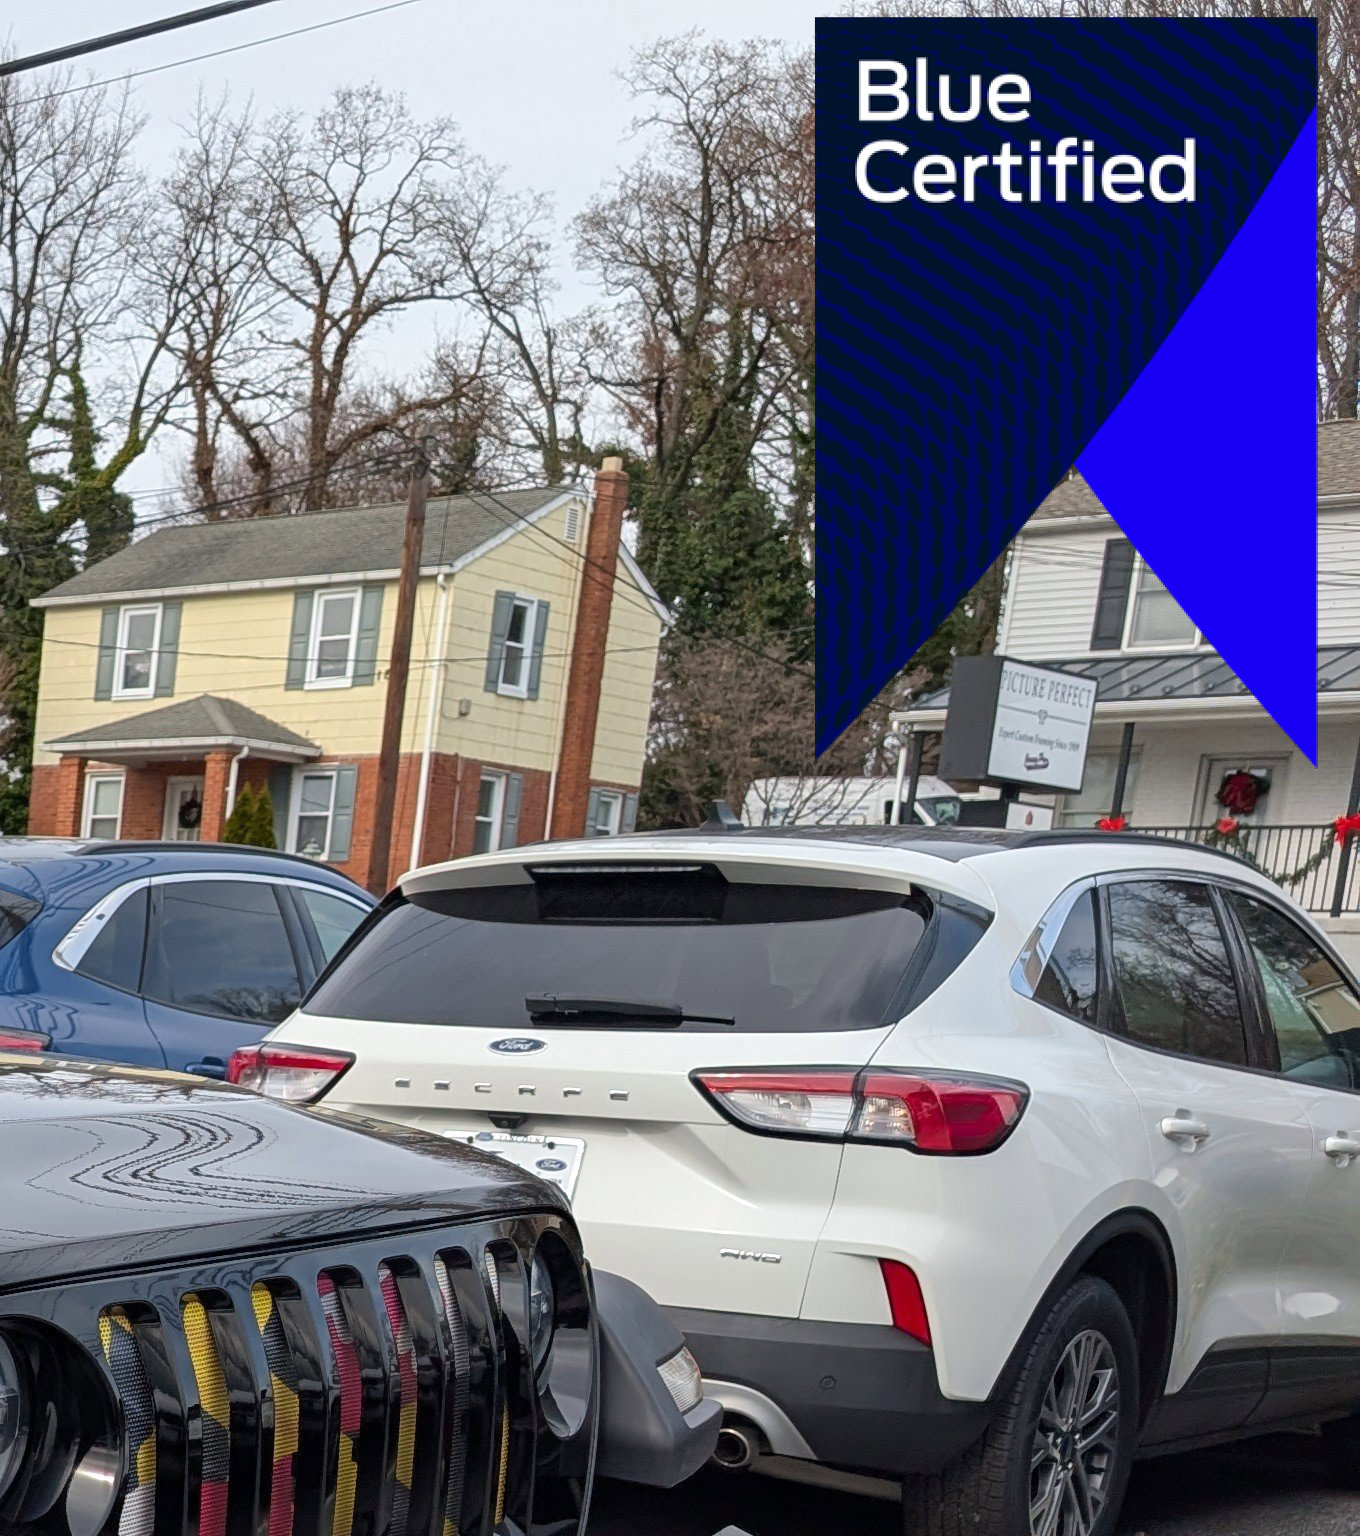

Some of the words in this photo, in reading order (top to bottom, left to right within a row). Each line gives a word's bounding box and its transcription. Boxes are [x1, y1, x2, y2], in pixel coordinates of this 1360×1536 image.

[1000, 669, 1047, 699] PICTURE
[1047, 680, 1093, 709] PERFECT
[498, 1038, 536, 1051] Ford
[394, 1077, 630, 1102] ESCAPE
[720, 1248, 781, 1264] AWD
